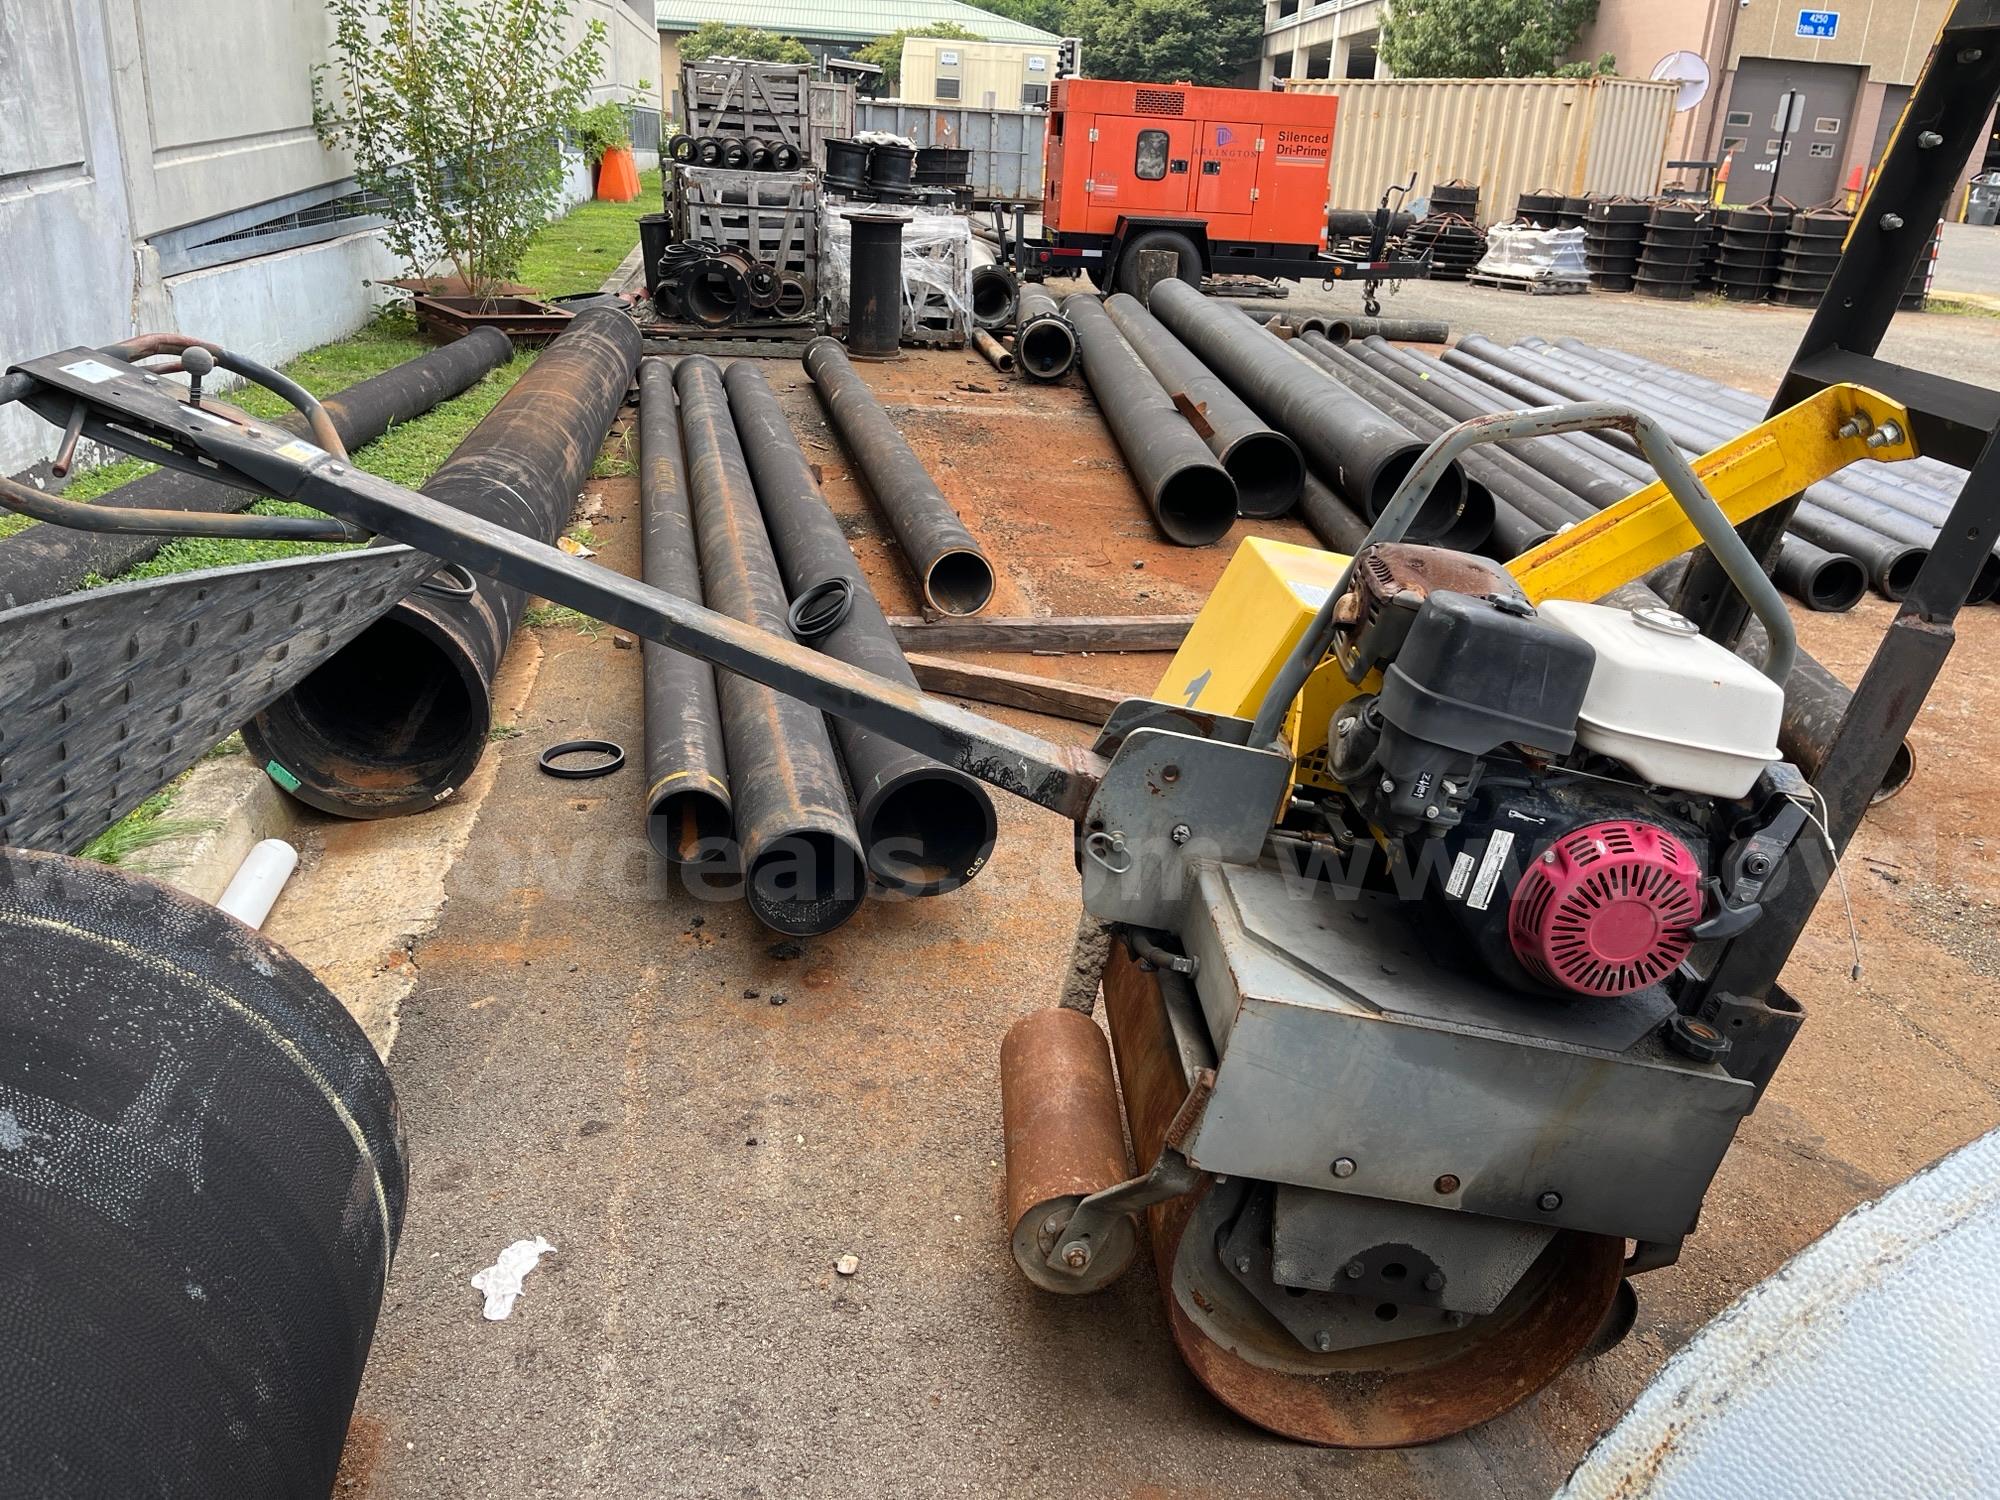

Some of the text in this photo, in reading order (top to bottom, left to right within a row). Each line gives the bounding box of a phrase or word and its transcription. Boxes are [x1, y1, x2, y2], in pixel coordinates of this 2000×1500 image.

[1810, 14, 1828, 24] 4250
[1278, 130, 1329, 144] Silenced
[1193, 148, 1257, 158] ARLINGTON
[1276, 143, 1328, 157] Dri-Prime
